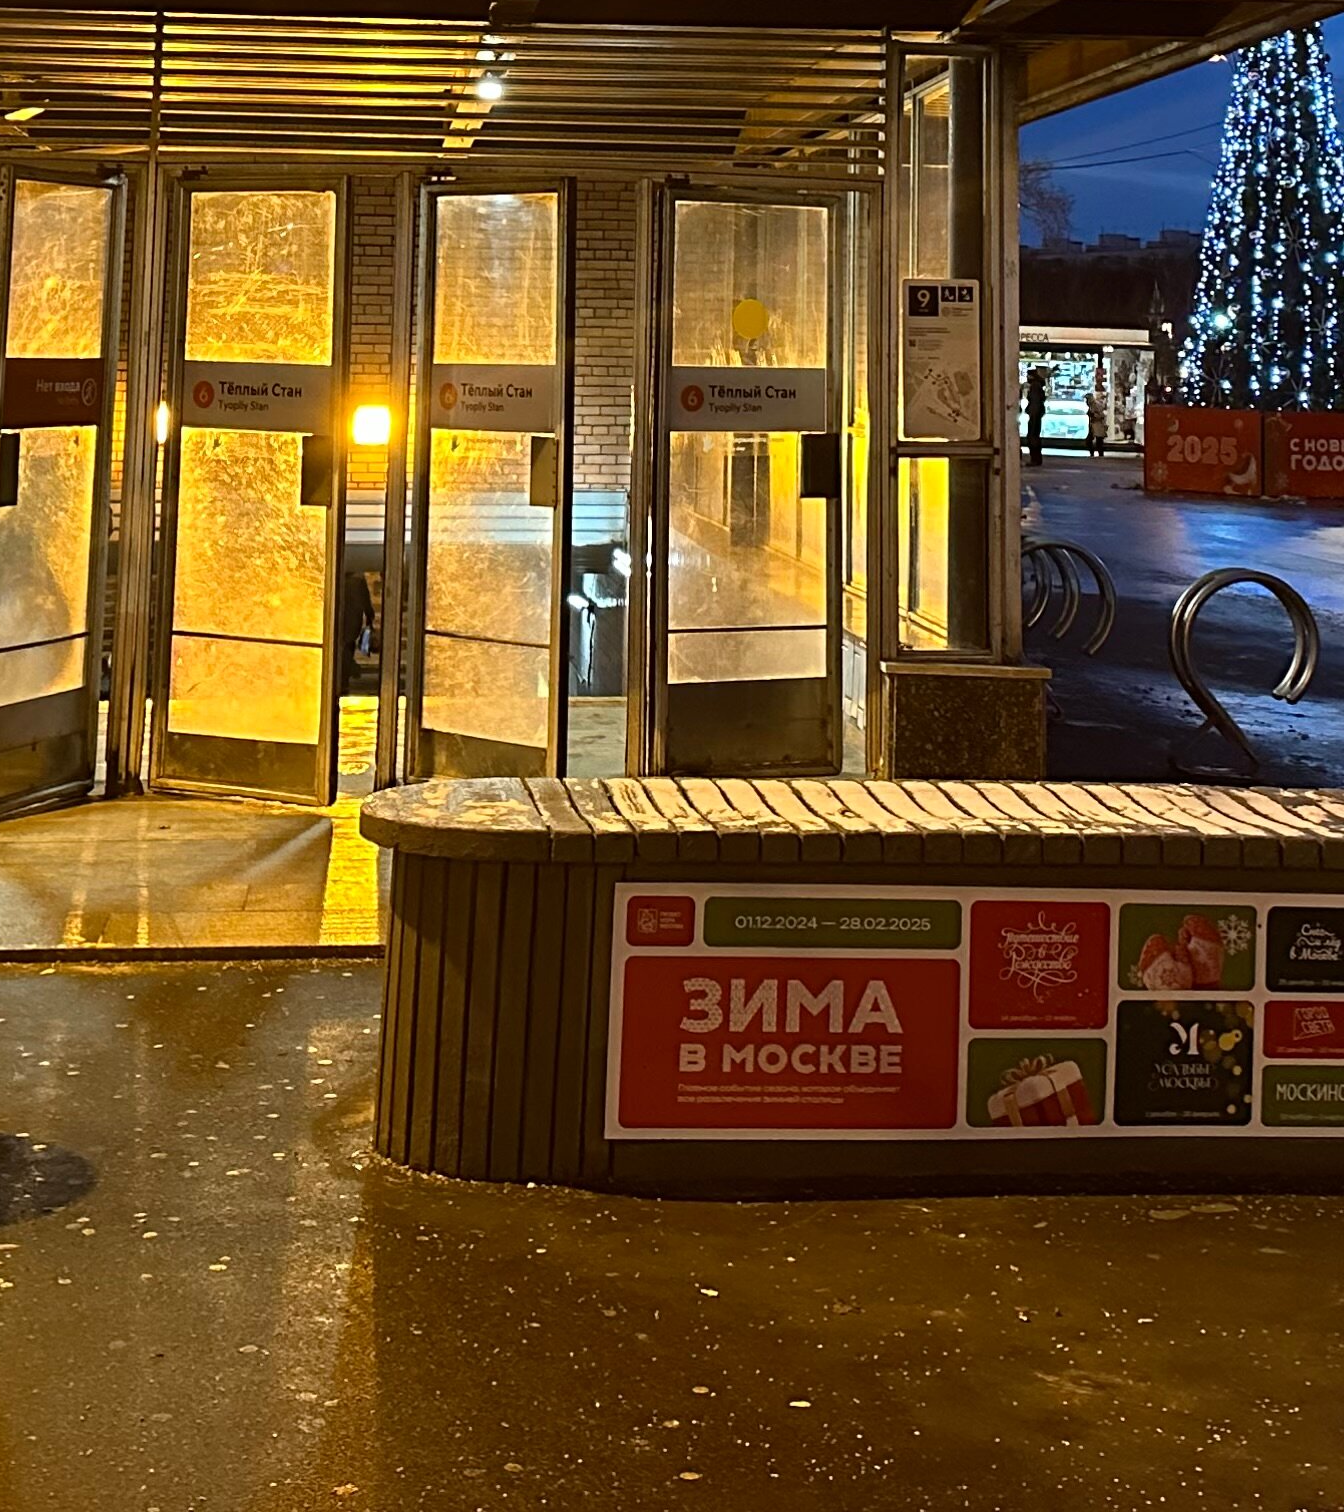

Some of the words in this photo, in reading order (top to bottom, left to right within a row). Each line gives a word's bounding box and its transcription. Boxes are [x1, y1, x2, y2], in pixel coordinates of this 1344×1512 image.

[916, 289, 931, 307] 9
[1019, 332, 1050, 342] РЕССА
[199, 388, 208, 403] 6
[218, 380, 269, 397] Тёплый
[271, 383, 302, 398] Стан
[460, 382, 504, 398] Тёплый
[505, 383, 533, 398] Стан
[708, 384, 762, 399] Тёплый
[764, 385, 797, 399] Стан
[250, 400, 269, 411] Stan
[687, 390, 698, 406] 6
[1166, 434, 1238, 466] 2025
[1289, 438, 1301, 452] С
[734, 915, 818, 929] 01.12.2024
[839, 917, 932, 931] 28.02.2025
[679, 977, 904, 1034] ЗИМА
[679, 1043, 706, 1073] В
[722, 1043, 903, 1074] МОСКВЕ
